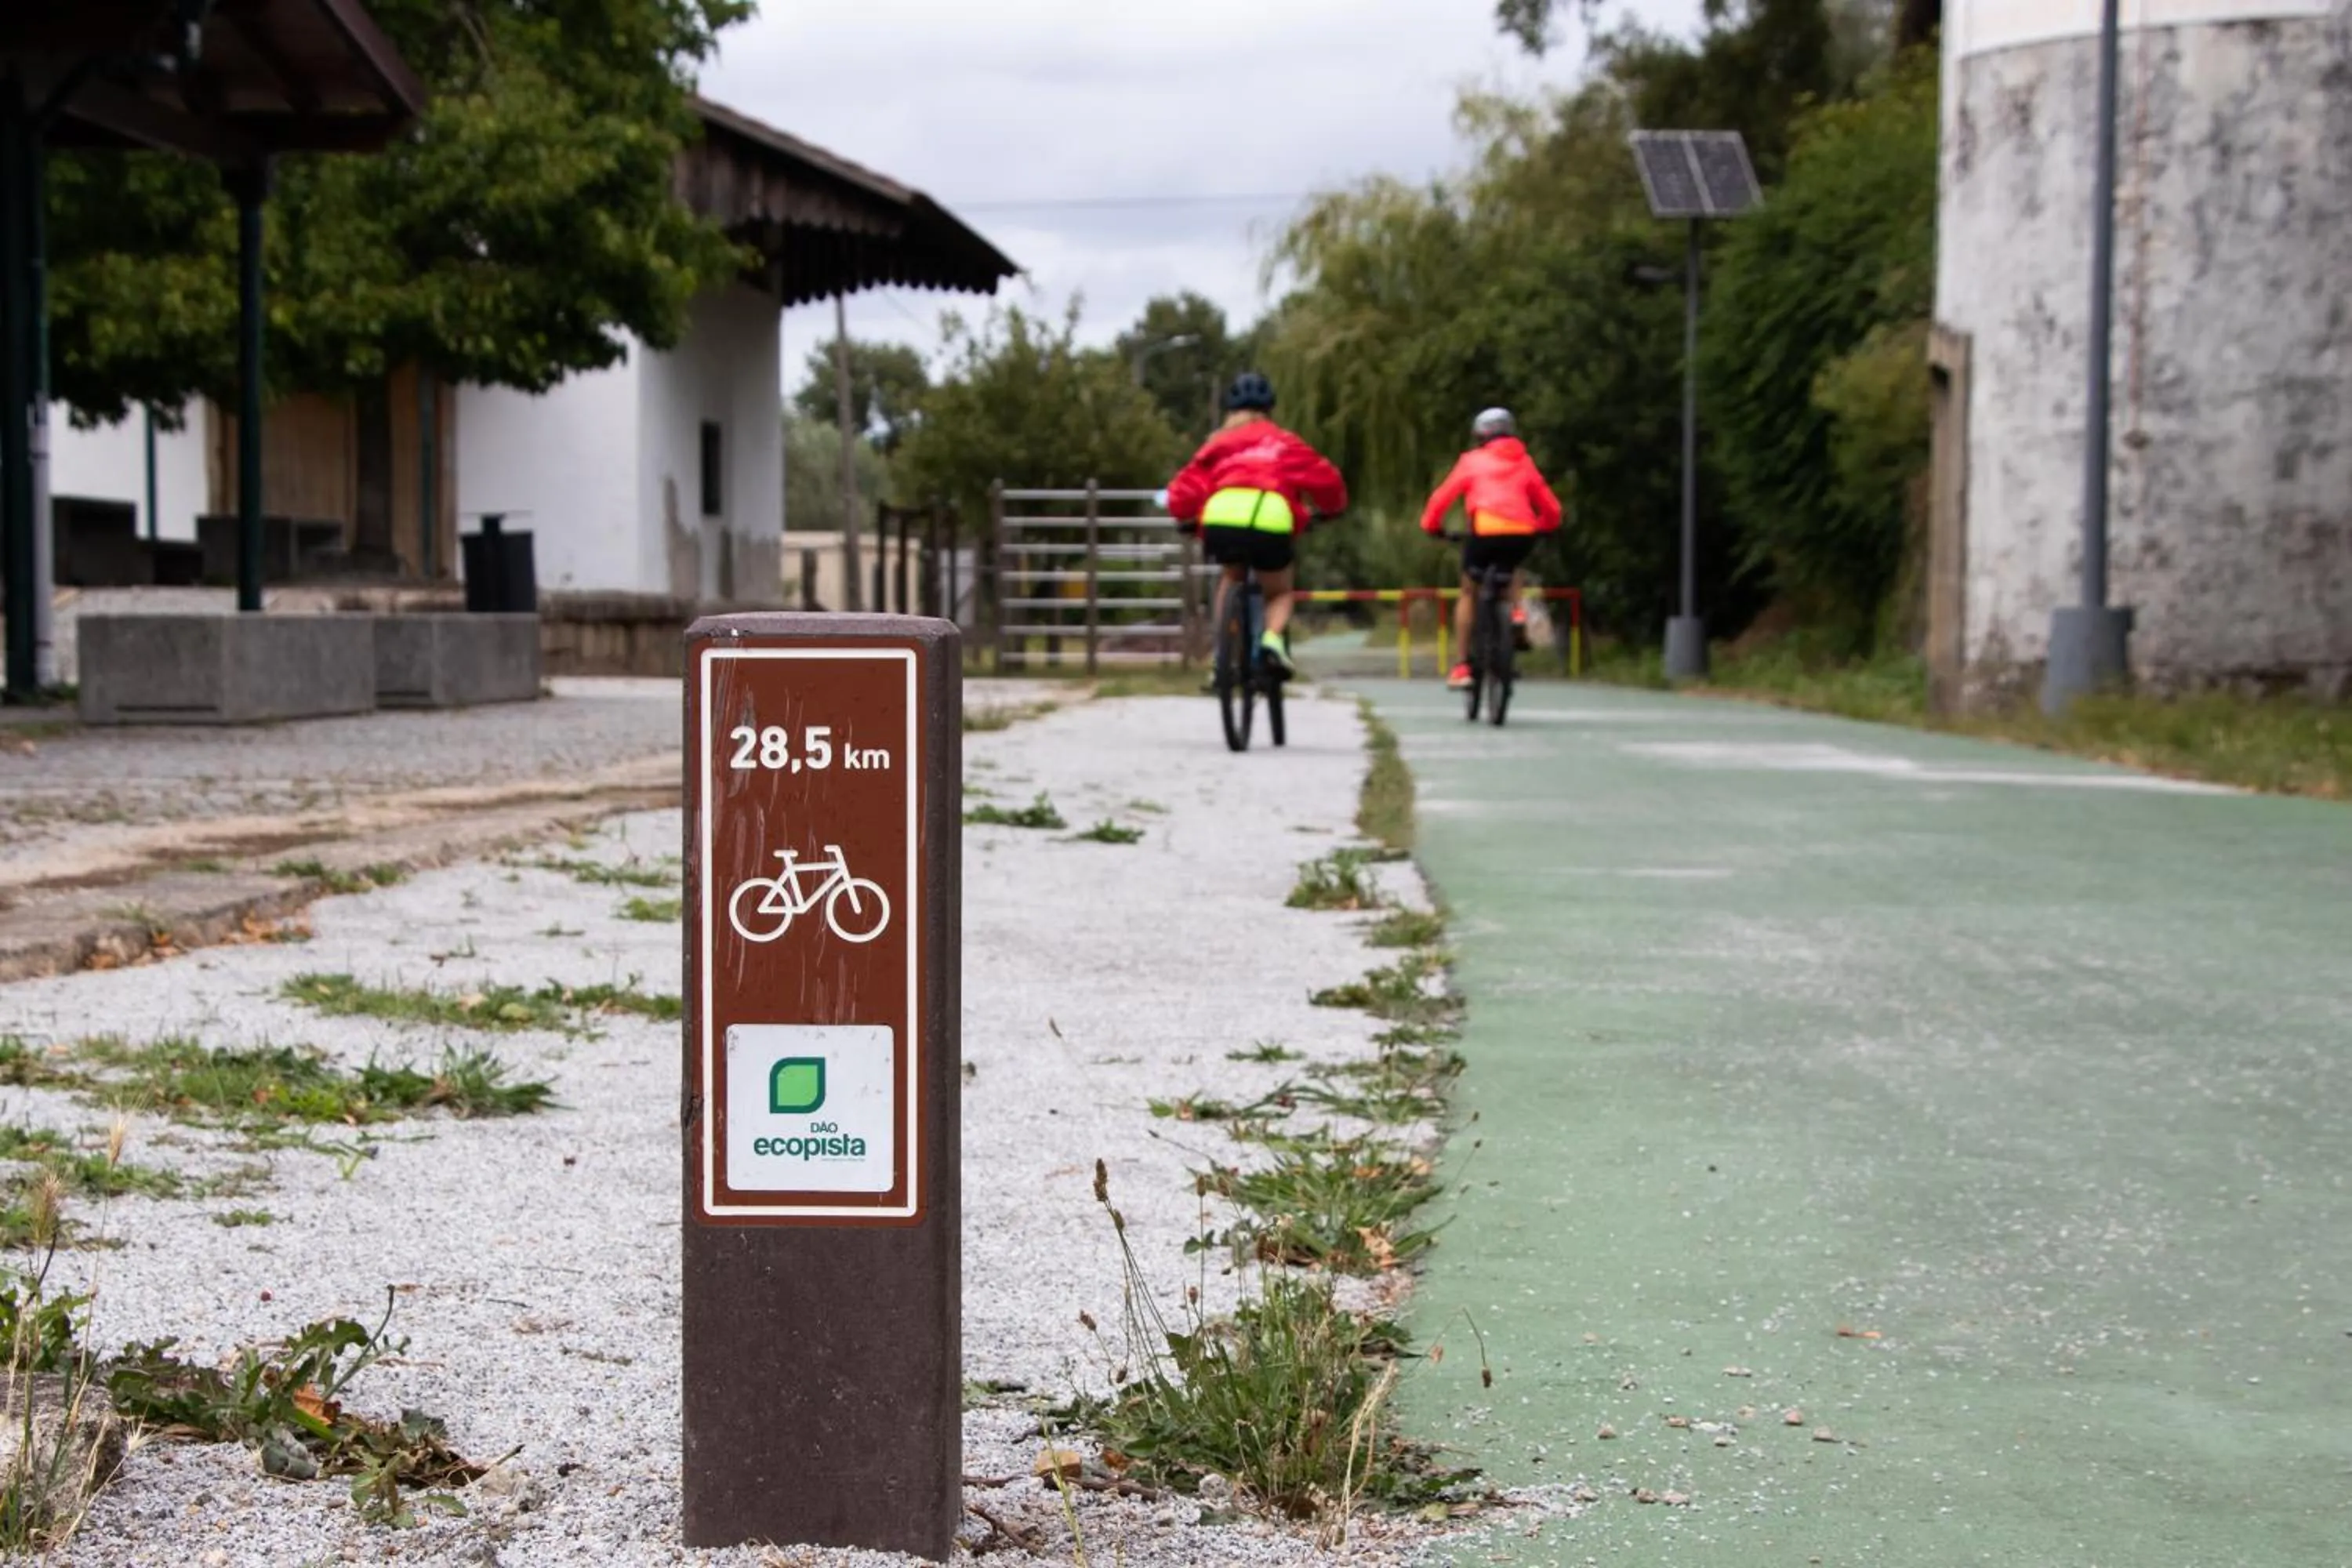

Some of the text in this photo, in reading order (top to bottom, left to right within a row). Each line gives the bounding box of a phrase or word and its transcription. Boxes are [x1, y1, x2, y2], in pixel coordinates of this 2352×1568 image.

[730, 725, 890, 774] 28,5 km
[753, 1133, 866, 1161] ecopista
